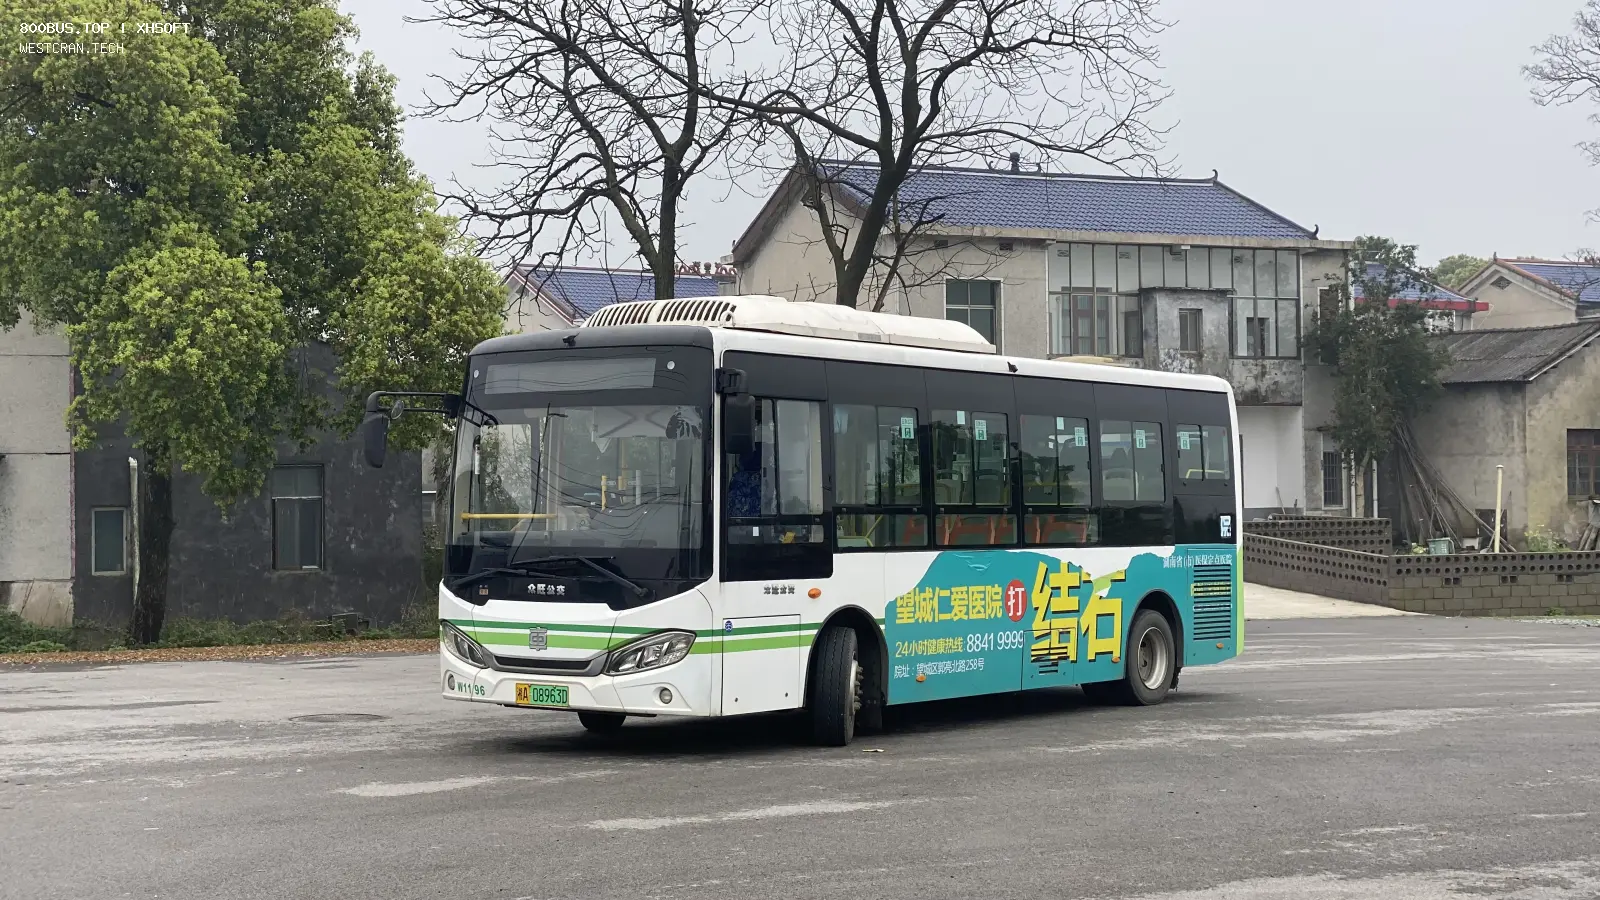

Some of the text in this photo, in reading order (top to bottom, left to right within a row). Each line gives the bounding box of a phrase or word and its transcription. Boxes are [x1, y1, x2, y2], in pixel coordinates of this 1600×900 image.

[896, 556, 1126, 663] 望城仁爱医院 打 结石
[966, 632, 994, 653] 8841
[997, 630, 1024, 650] 9999
[457, 681, 486, 696] W1196
